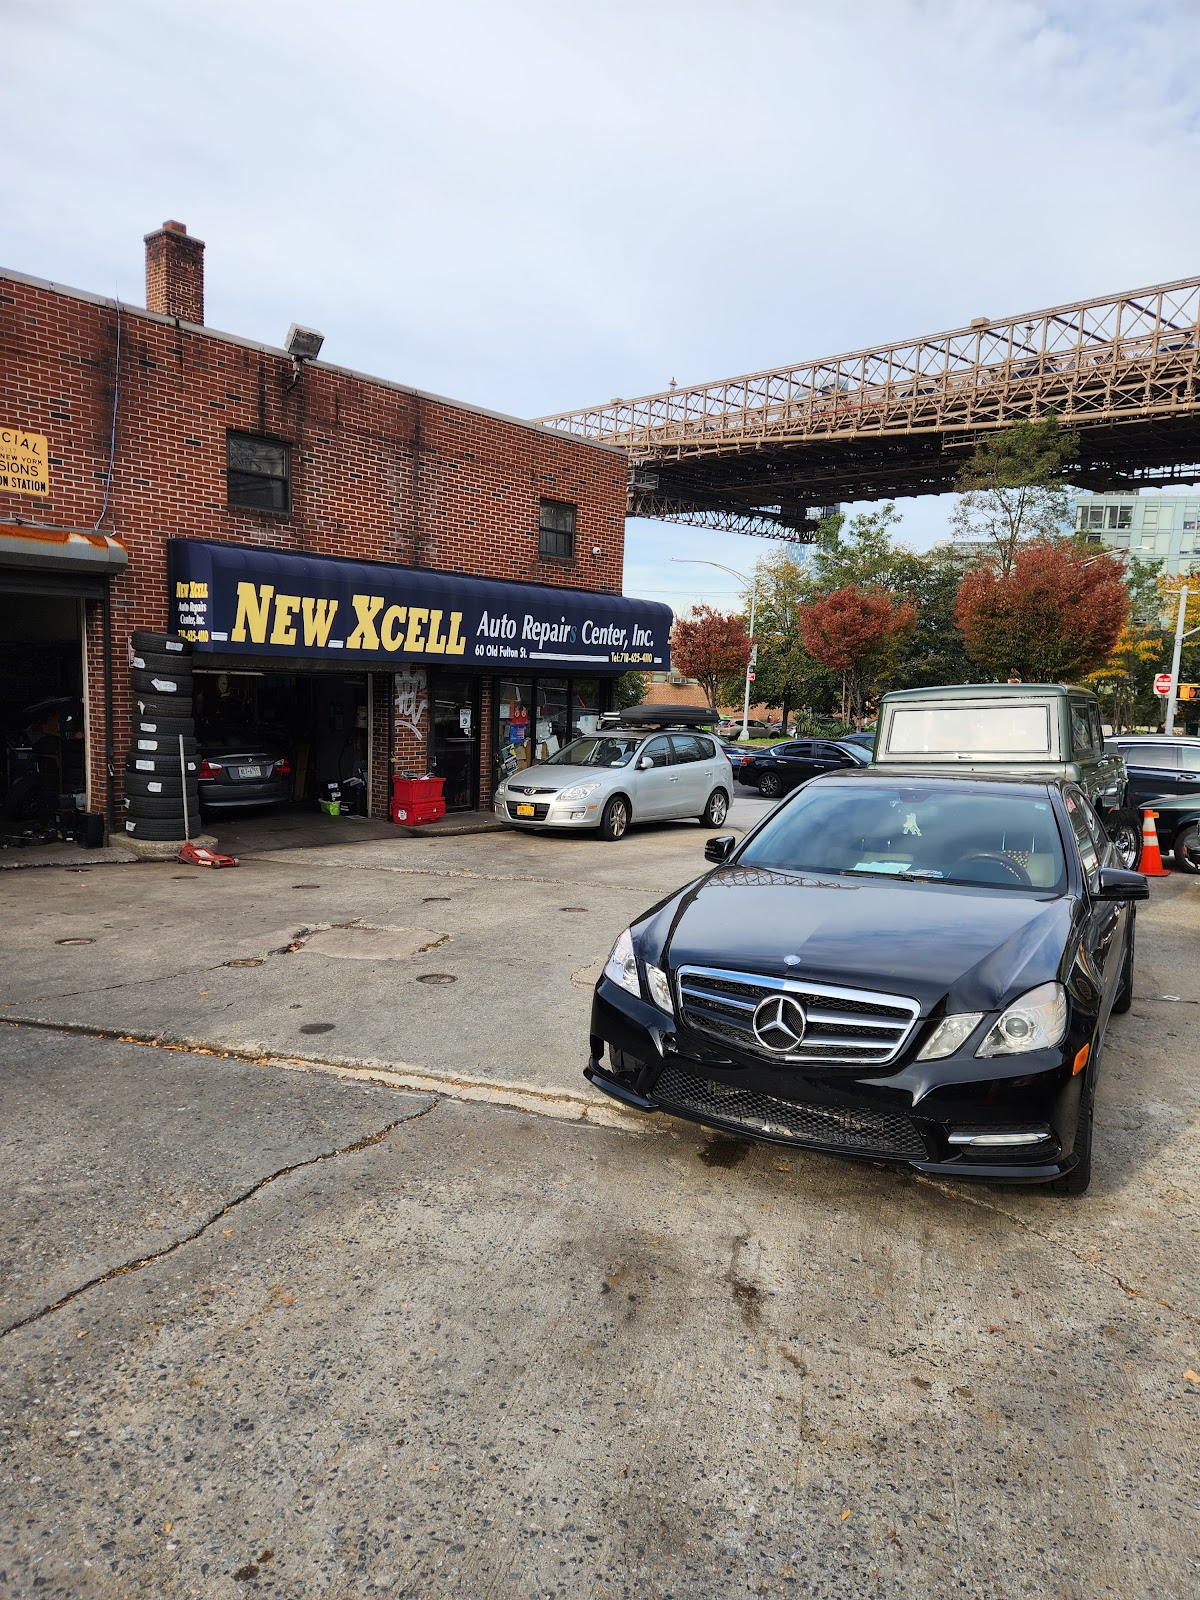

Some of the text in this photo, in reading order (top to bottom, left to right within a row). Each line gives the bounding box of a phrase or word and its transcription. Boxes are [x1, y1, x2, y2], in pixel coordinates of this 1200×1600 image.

[2, 432, 40, 455] CIAL
[21, 457, 43, 465] YORK
[11, 477, 46, 492] STATION
[231, 581, 466, 655] NEW XCELL
[476, 610, 517, 639] Auto
[521, 614, 578, 649] Repairs
[581, 620, 629, 651] Center,
[632, 623, 654, 647] Inc.
[474, 644, 528, 659] 60 Old Fulton St.
